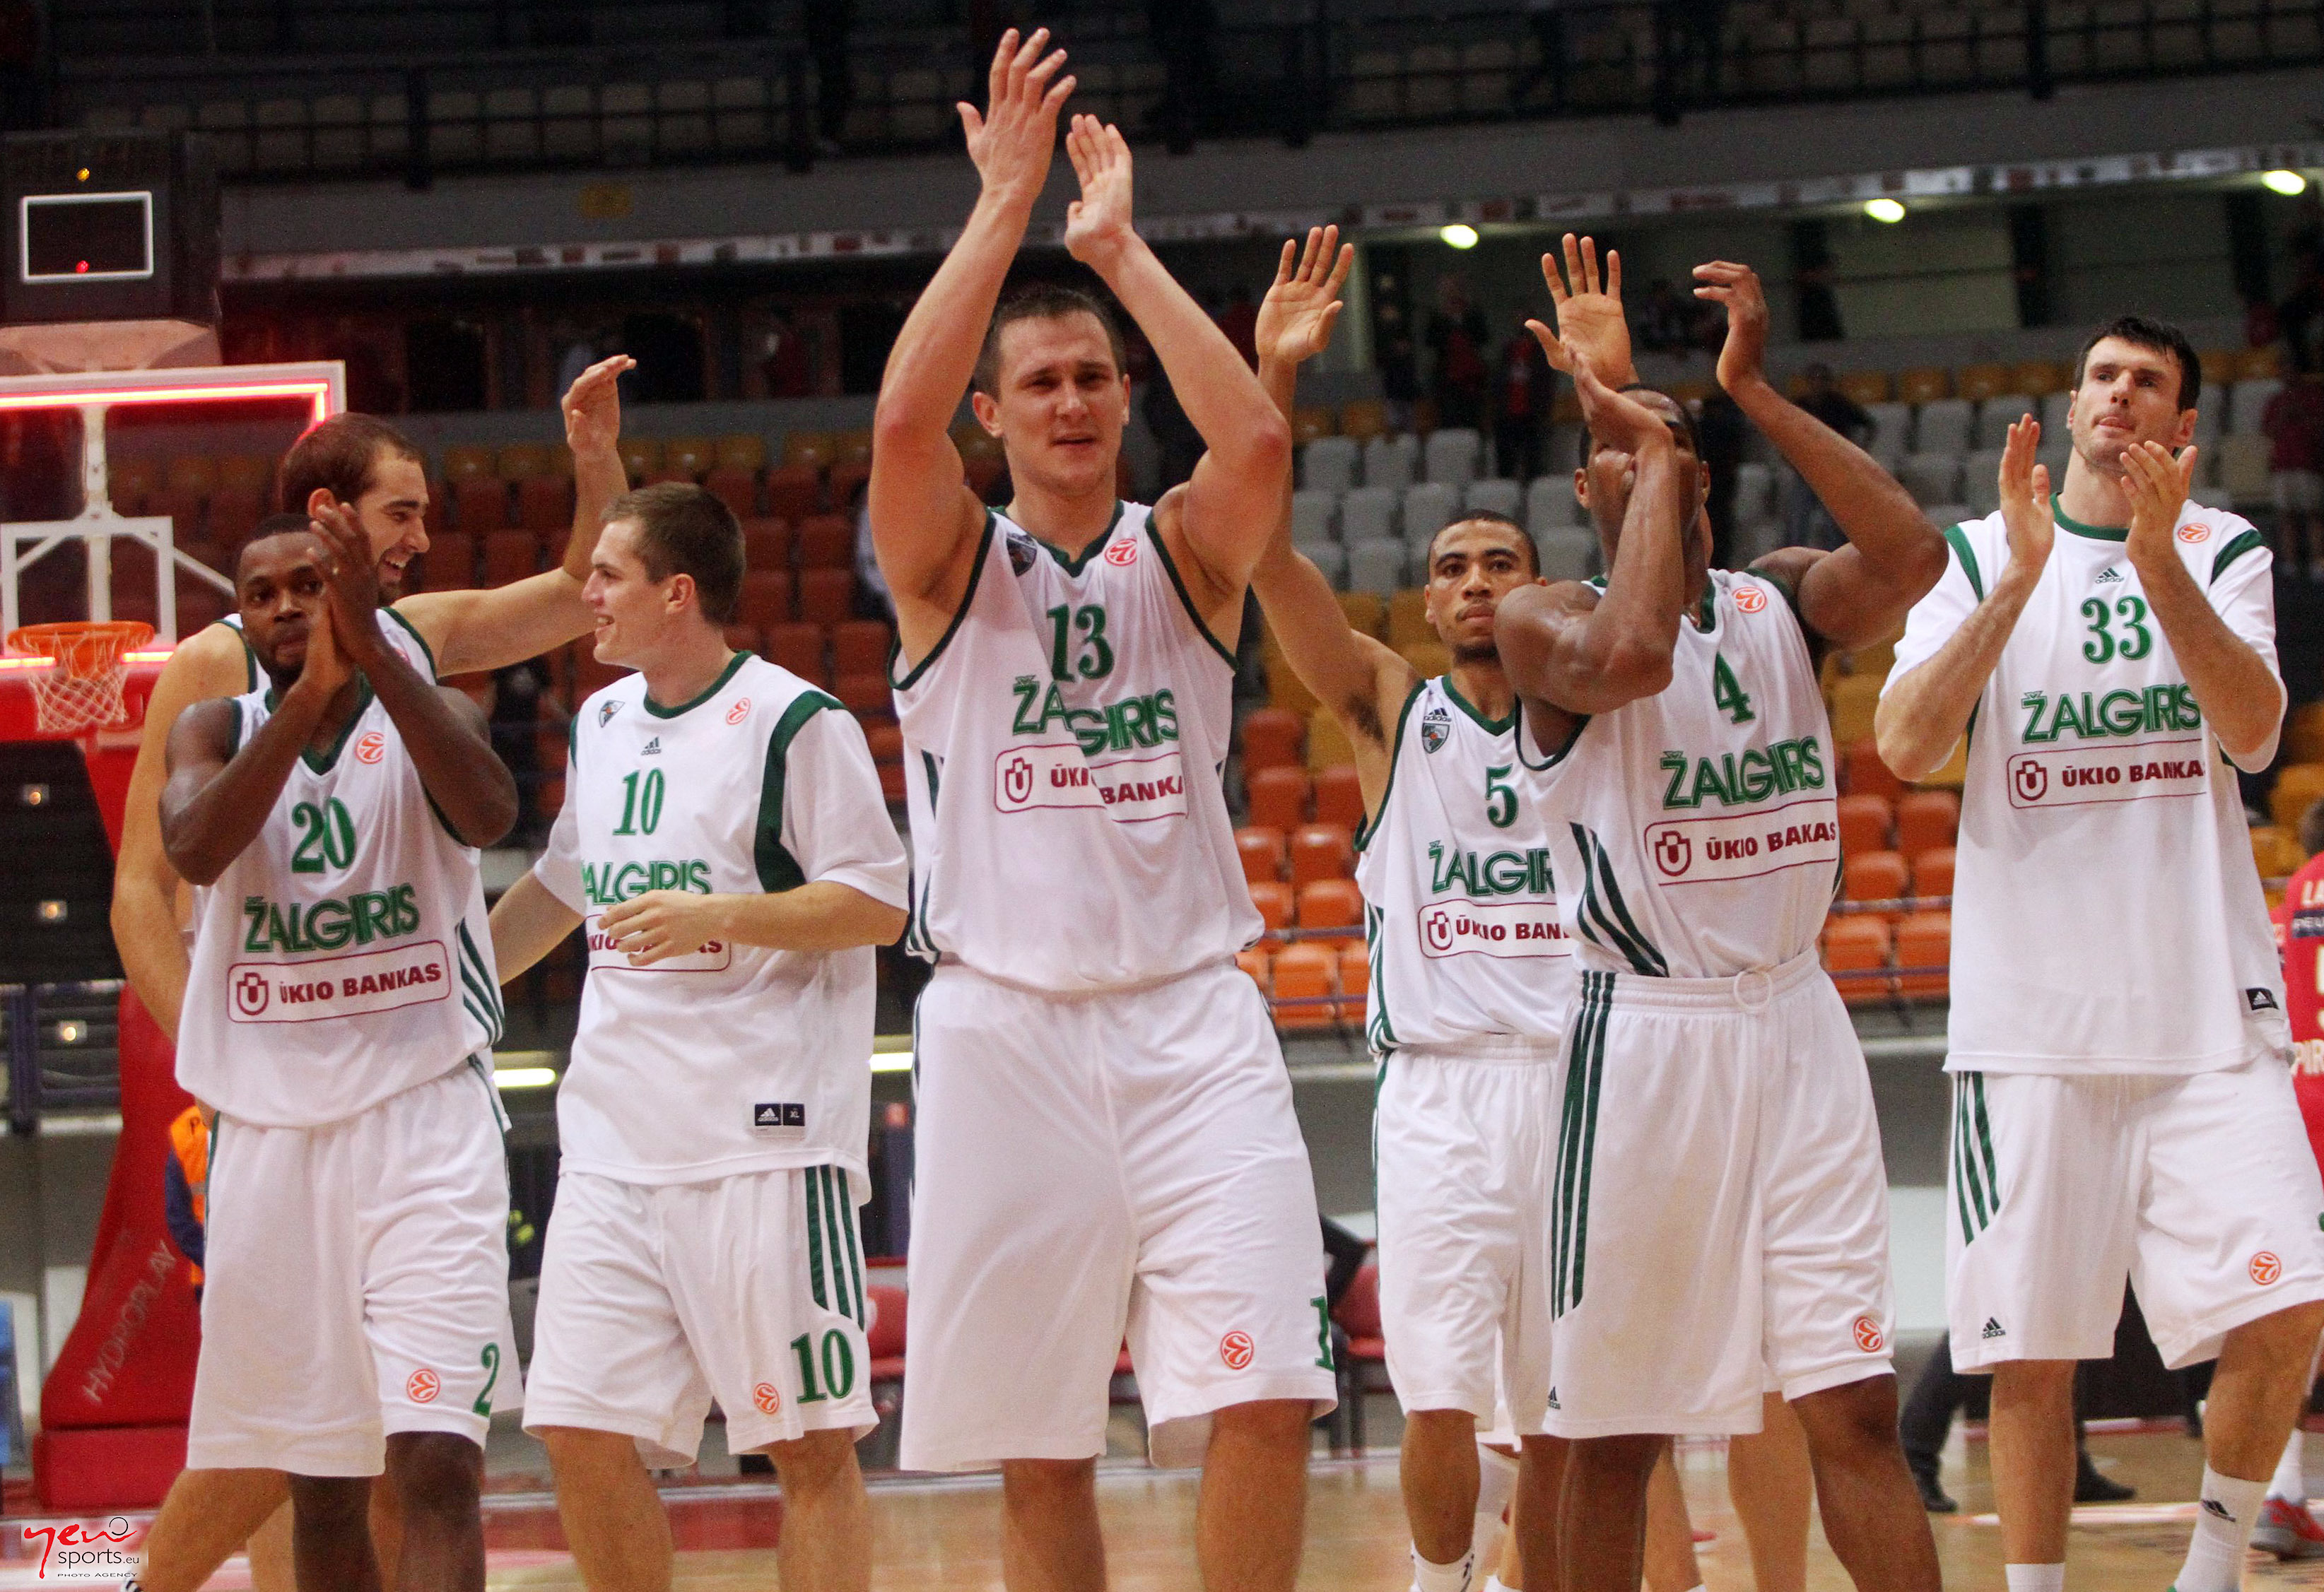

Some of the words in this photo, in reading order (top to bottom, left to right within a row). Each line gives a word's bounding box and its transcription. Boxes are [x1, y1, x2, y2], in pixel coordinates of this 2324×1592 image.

[1046, 603, 1115, 683] 13
[2080, 595, 2152, 664] 33
[1012, 675, 1180, 757] ŽAGIRIS
[1714, 651, 1756, 724] 4
[612, 767, 666, 836] 10
[1050, 763, 1097, 788] ŪKI
[1099, 776, 1183, 804] BANK
[1486, 763, 1519, 827] 5
[1660, 736, 1825, 810] ŽALGIRS
[2062, 765, 2120, 787] ŪKIO
[2130, 760, 2205, 782] BANKA
[291, 796, 357, 873] 20
[1428, 840, 1556, 897] ŽALGIR
[1706, 837, 1759, 860] ŪKIO
[1766, 822, 1836, 852] BAKAS
[580, 859, 713, 905] ALGIRIS
[245, 883, 420, 953] ŽALGIRIS
[588, 934, 621, 950] KIO
[342, 963, 442, 997] BANKAS
[790, 1328, 855, 1403] 10
